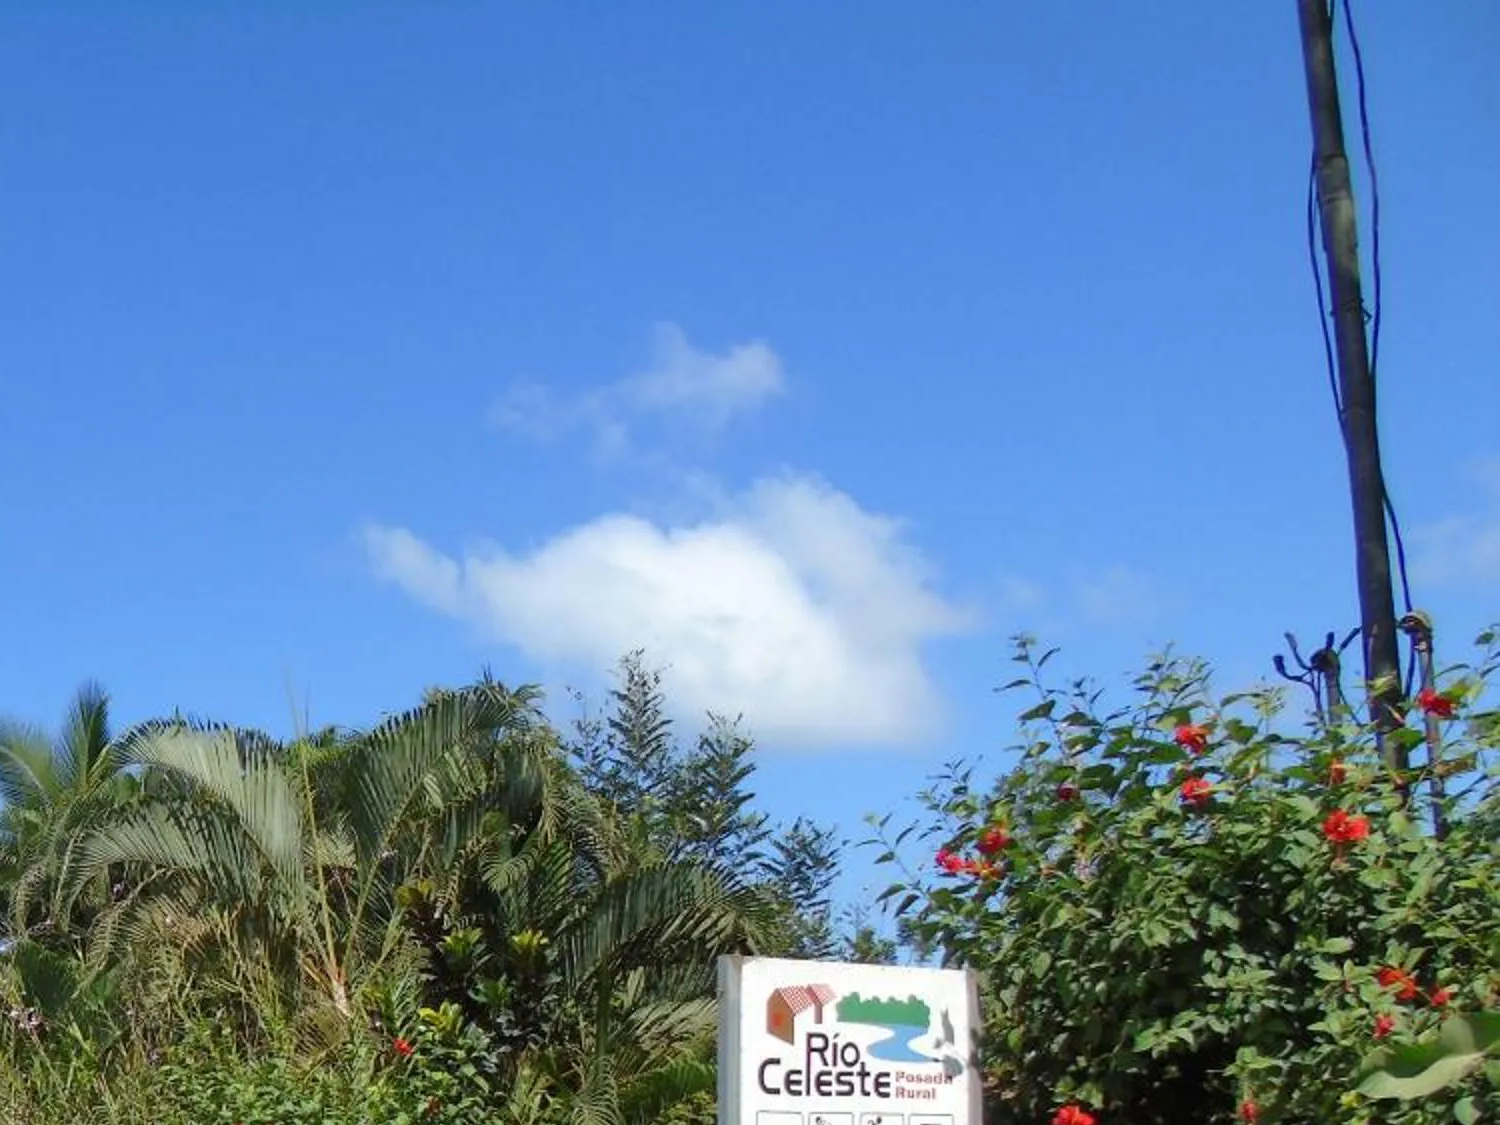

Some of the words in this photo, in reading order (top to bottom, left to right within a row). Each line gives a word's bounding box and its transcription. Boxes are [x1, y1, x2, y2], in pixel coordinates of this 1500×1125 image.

[806, 1032, 860, 1067] Río
[758, 1058, 891, 1098] Celeste
[895, 1071, 953, 1085] Posada
[895, 1087, 937, 1099] Rural
